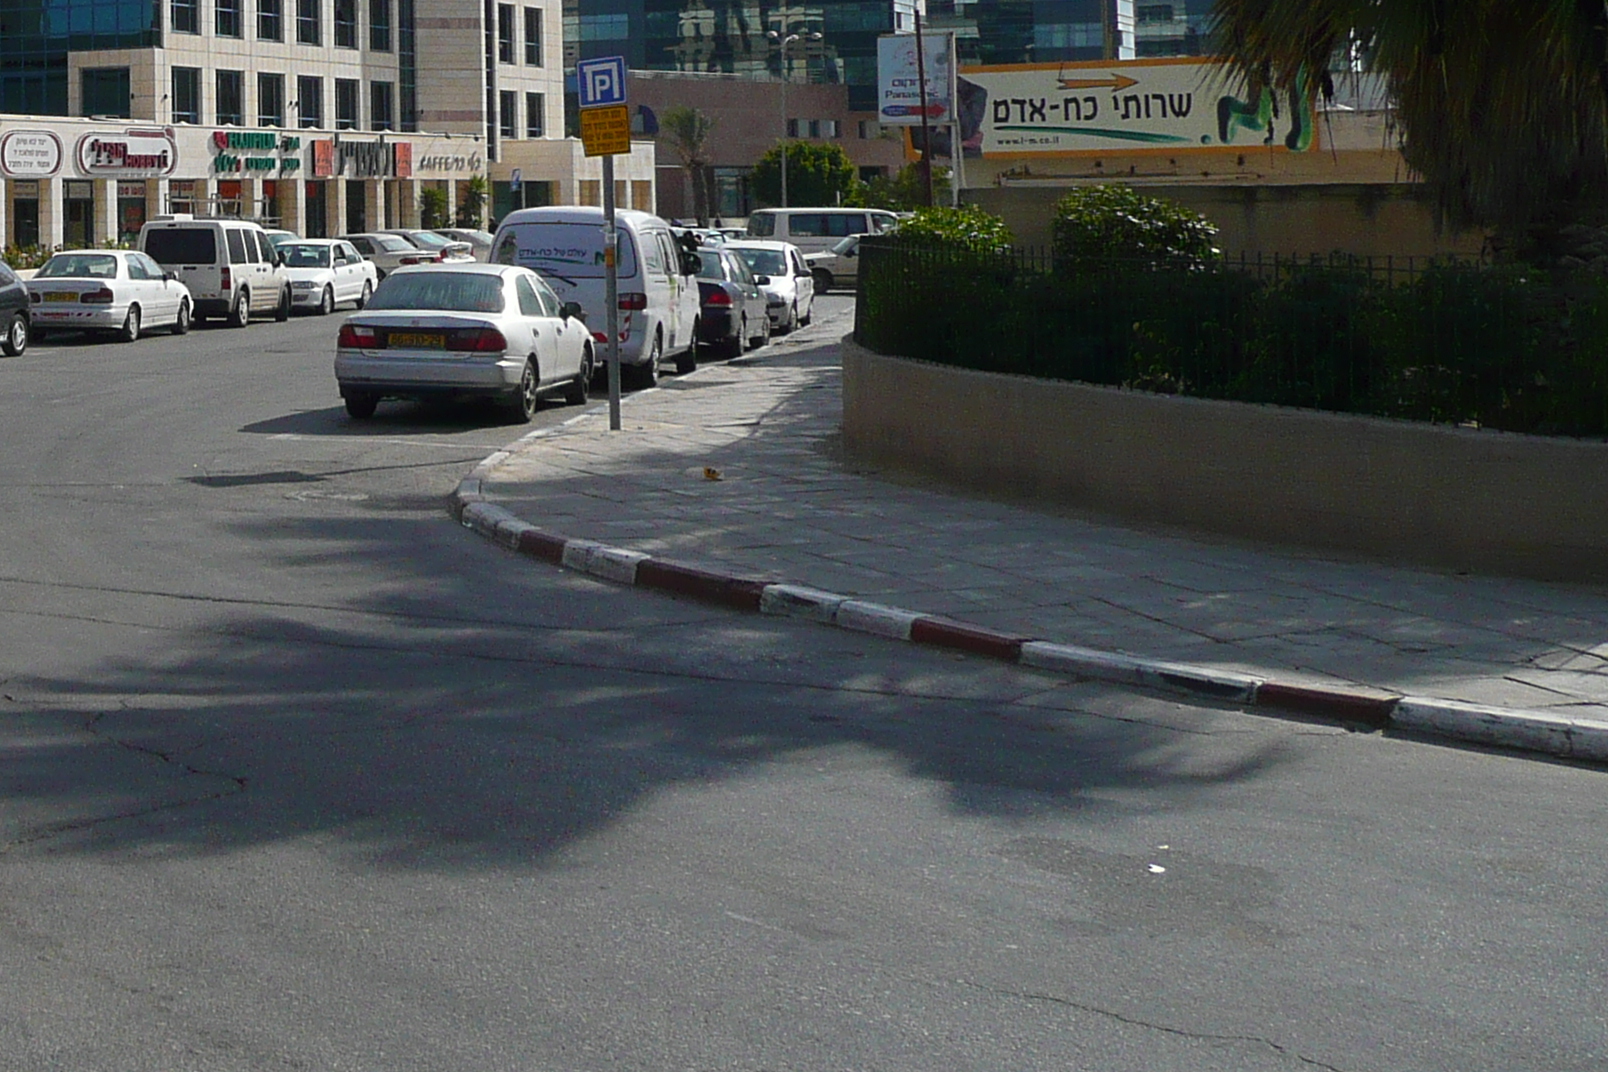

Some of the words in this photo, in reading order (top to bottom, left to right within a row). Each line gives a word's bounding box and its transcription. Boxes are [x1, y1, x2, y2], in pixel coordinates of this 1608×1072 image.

[992, 96, 1099, 124] כח-אדם
[1112, 92, 1193, 120] שרותי
[225, 132, 276, 149] FUJIFILM
